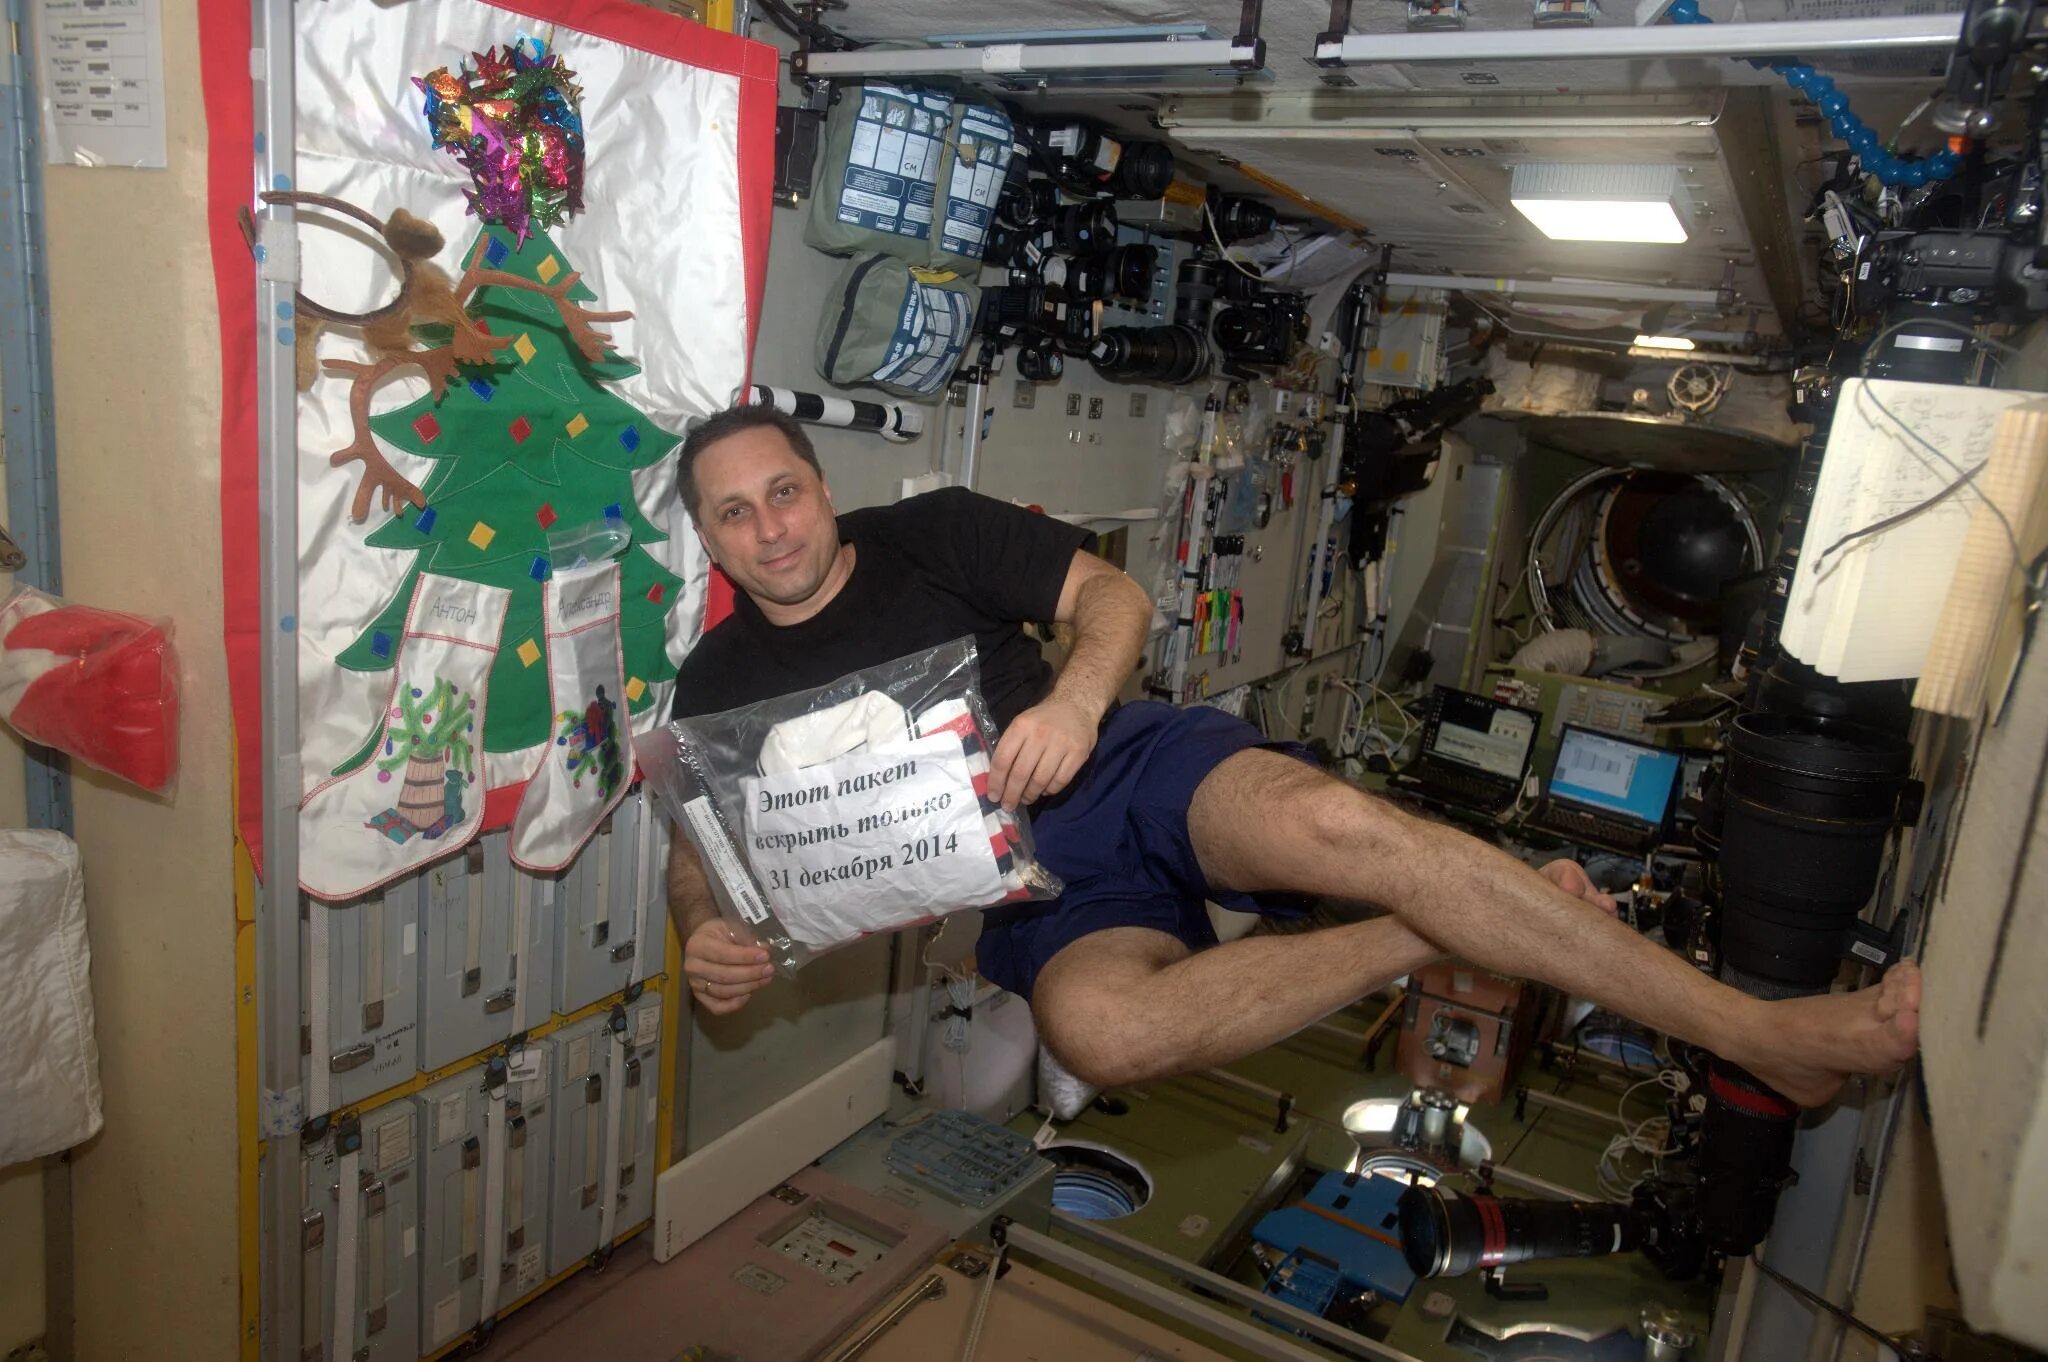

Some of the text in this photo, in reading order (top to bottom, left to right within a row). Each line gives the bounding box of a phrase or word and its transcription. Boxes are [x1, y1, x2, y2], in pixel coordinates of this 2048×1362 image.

[759, 759, 918, 812] Этот пакет
[755, 792, 952, 853] вскрыть только
[769, 868, 791, 890] 31
[799, 854, 894, 888] декабря
[901, 831, 958, 867] 2014
